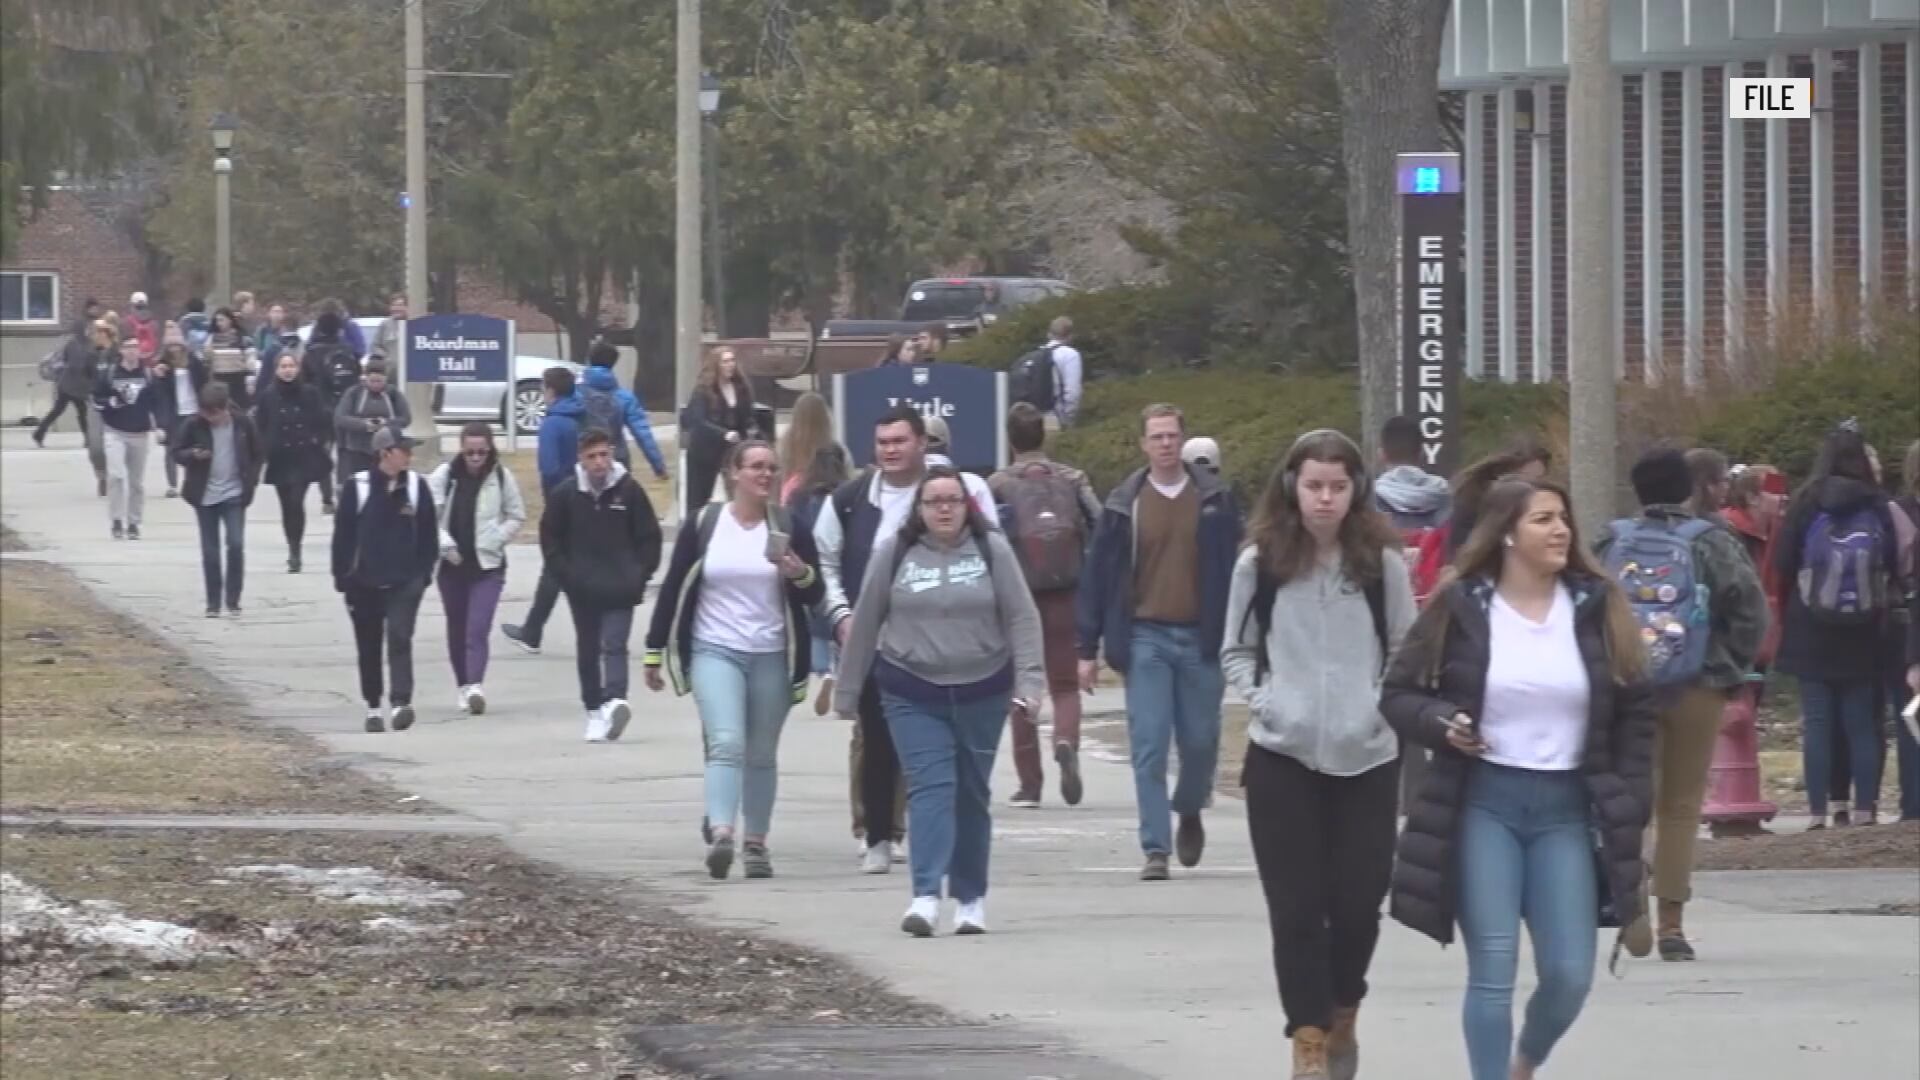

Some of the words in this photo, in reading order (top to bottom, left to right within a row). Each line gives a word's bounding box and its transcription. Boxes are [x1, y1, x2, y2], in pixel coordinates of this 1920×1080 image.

[414, 335, 500, 350] Boardman
[1418, 236, 1443, 465] EMERGENCY
[439, 356, 475, 371] Hall
